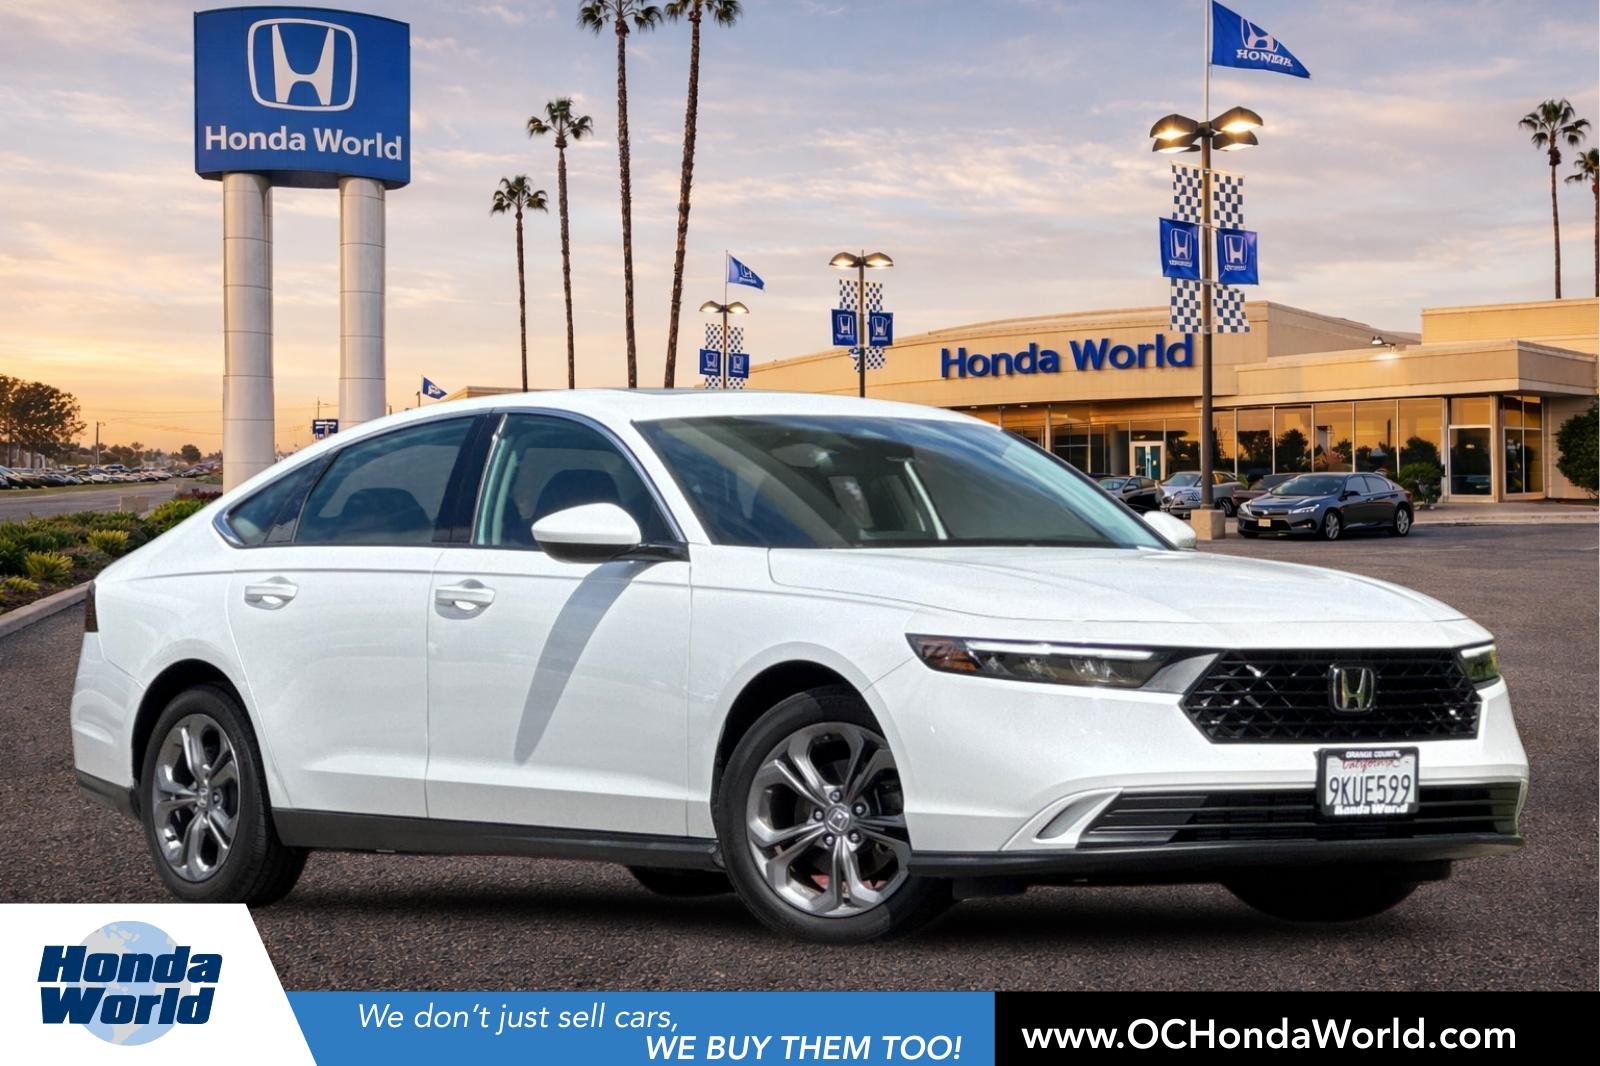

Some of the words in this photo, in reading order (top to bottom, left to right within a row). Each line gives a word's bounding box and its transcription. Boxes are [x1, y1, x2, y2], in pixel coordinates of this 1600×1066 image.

[205, 125, 306, 152] Honda
[312, 128, 403, 161] World
[940, 342, 1060, 380] Honda
[1069, 333, 1194, 371] World
[1329, 774, 1412, 807] 9KUE599
